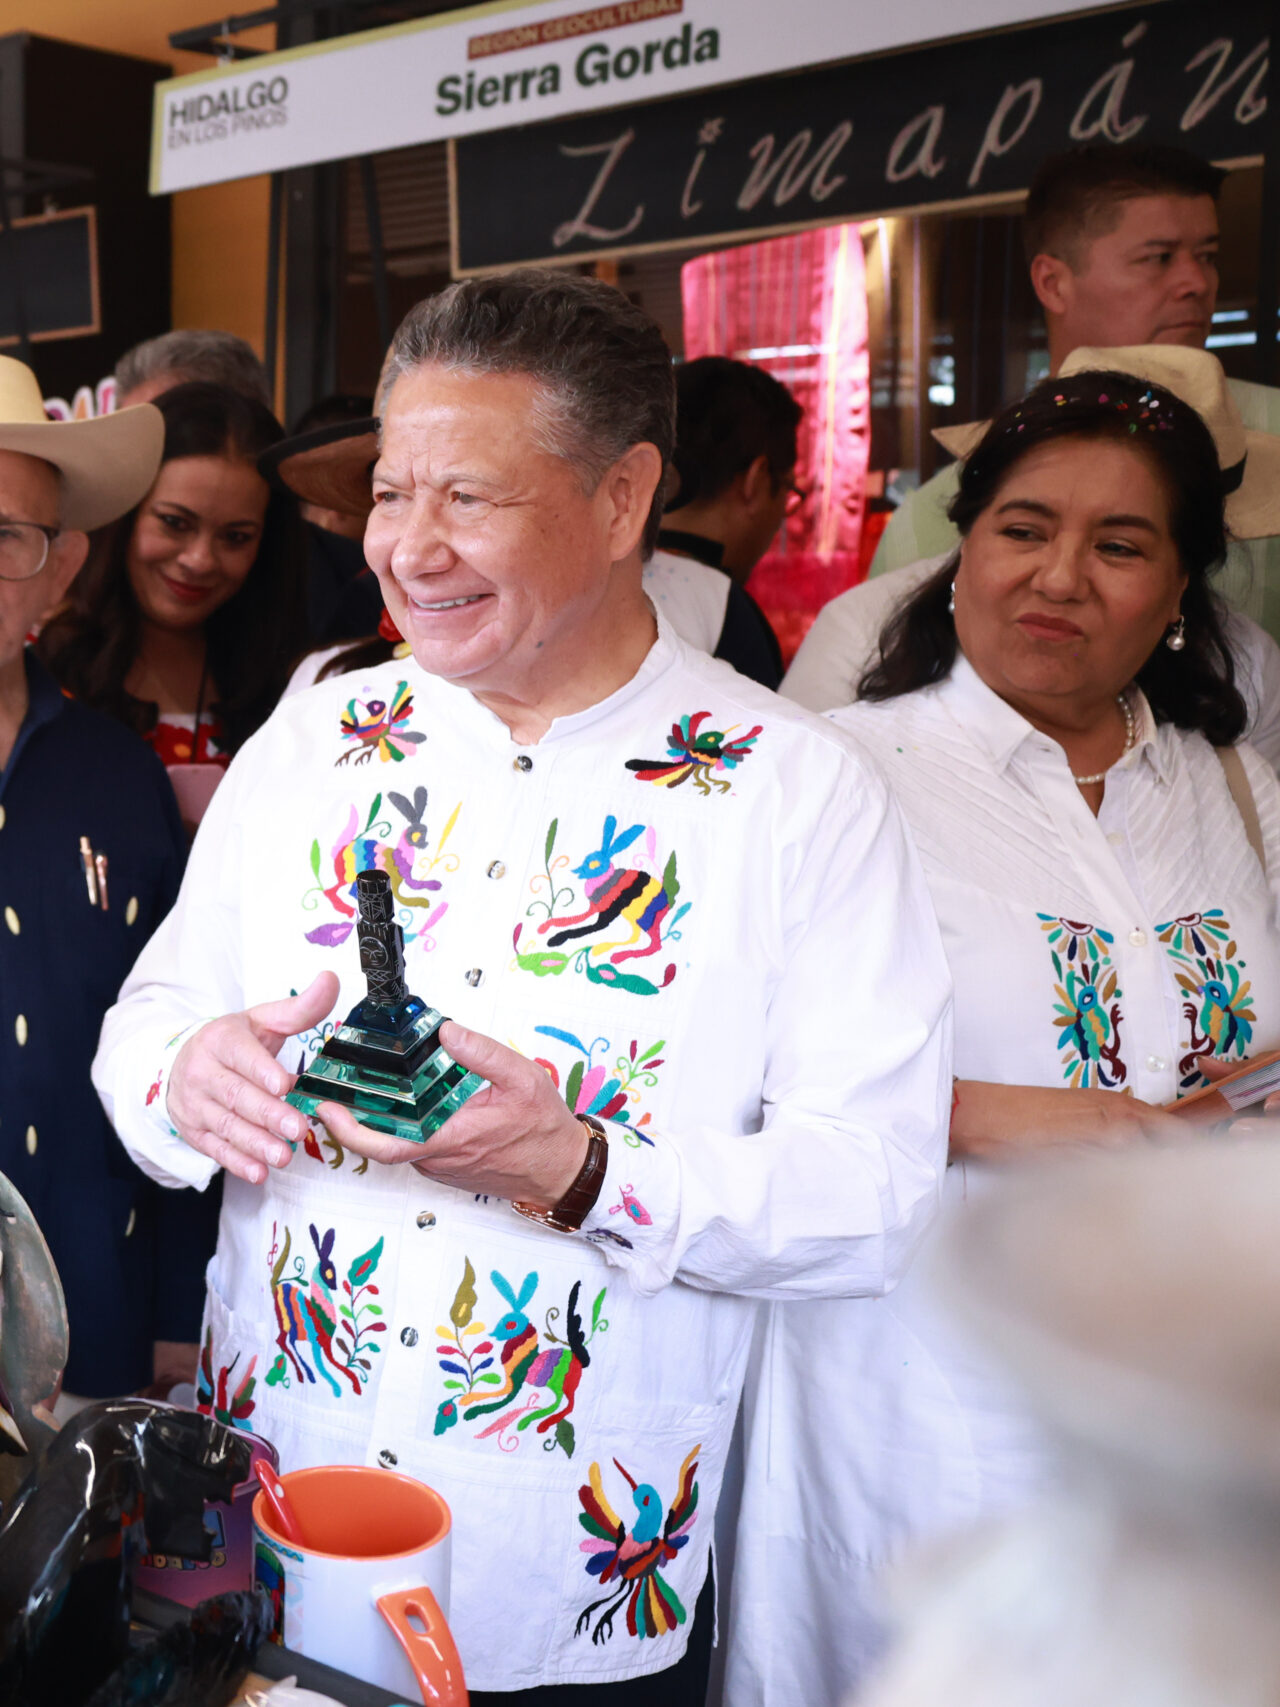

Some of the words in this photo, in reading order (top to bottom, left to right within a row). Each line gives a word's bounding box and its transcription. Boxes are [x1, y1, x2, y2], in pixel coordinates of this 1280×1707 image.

[435, 62, 560, 117] Sierra
[575, 21, 720, 87] Gorda
[169, 75, 289, 127] HIDALGO
[169, 127, 191, 149] EN
[194, 121, 228, 145] LOS
[232, 108, 288, 134] PINOS
